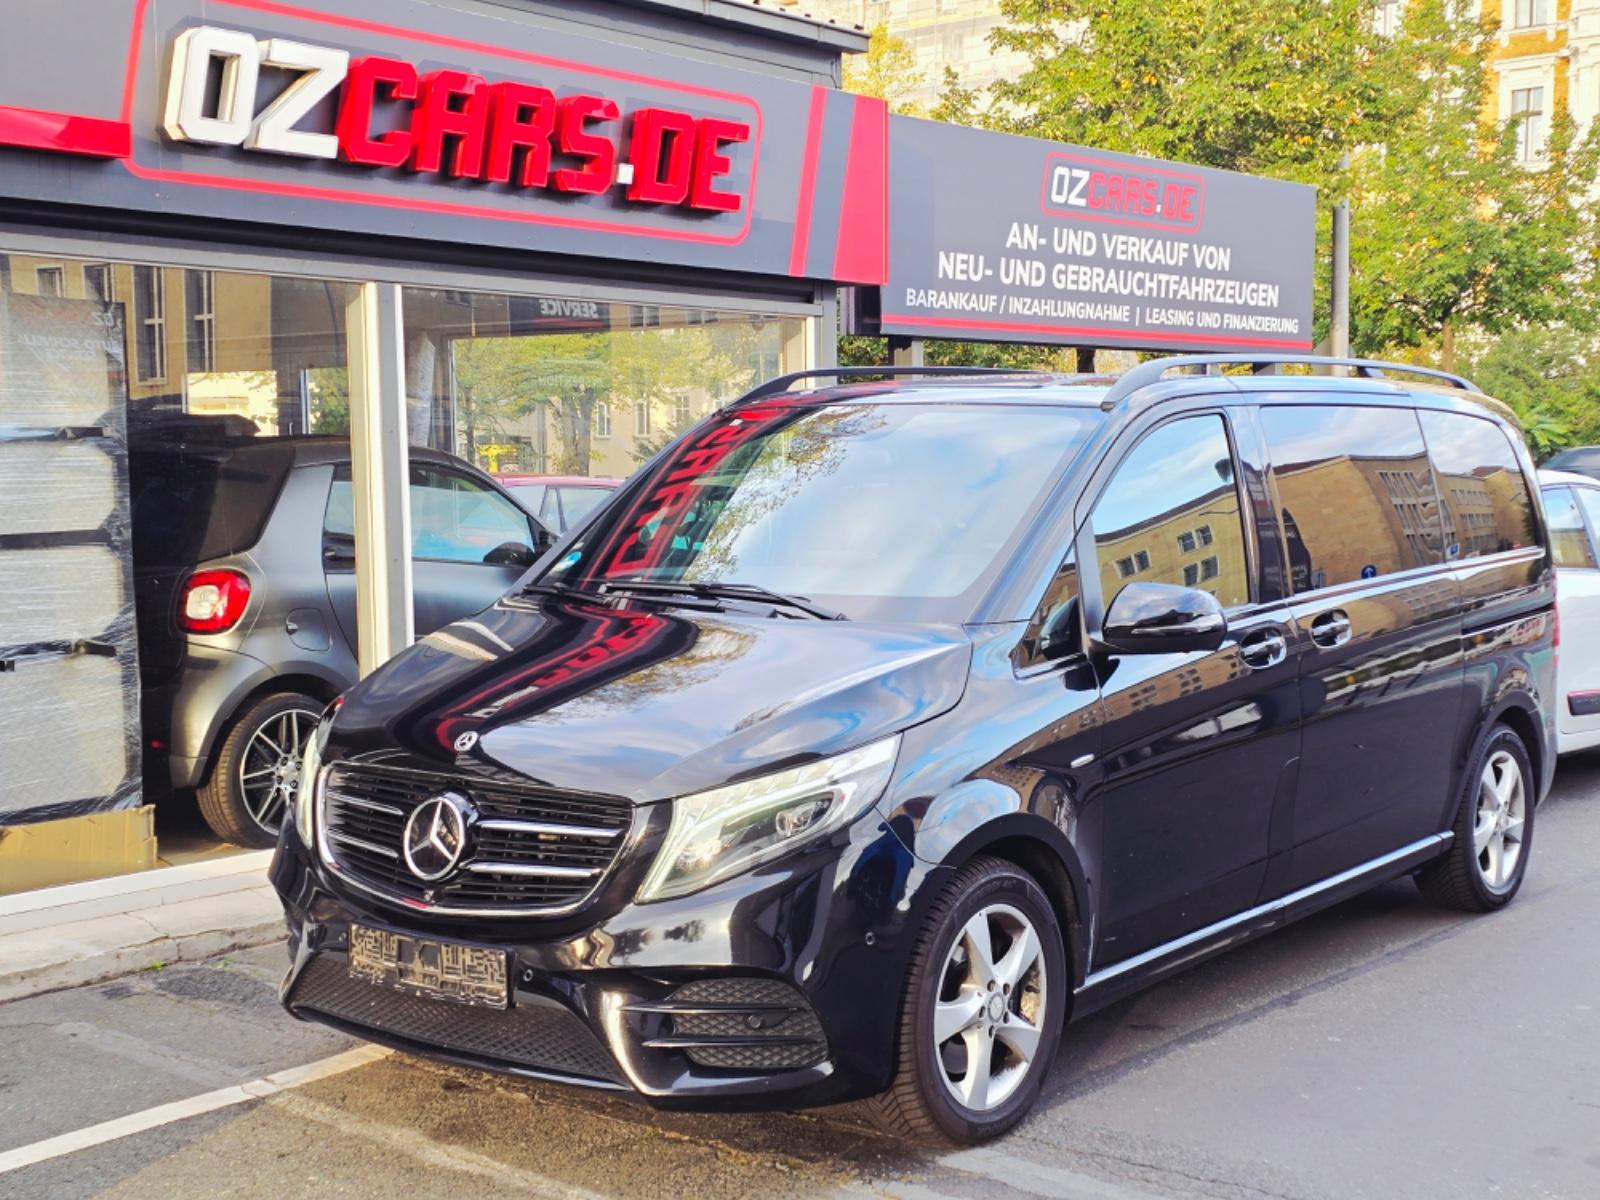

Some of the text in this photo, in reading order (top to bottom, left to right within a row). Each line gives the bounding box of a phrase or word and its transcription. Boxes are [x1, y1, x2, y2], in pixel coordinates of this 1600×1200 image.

[162, 25, 750, 213] OZCARS.DE
[1050, 165, 1197, 221] OZCARS.DE
[1006, 222, 1231, 272] AN- UND VERKAUF VON
[938, 251, 1279, 308] NEU- UND GEBRAUCHTFAHRZEUGEN
[906, 288, 998, 313] BARANKAUF
[1009, 297, 1130, 323] INZAHLUNGNAHME
[1145, 307, 1194, 328] LEASING
[1197, 311, 1221, 330] UND
[1223, 313, 1299, 335] FINANZIERUNG
